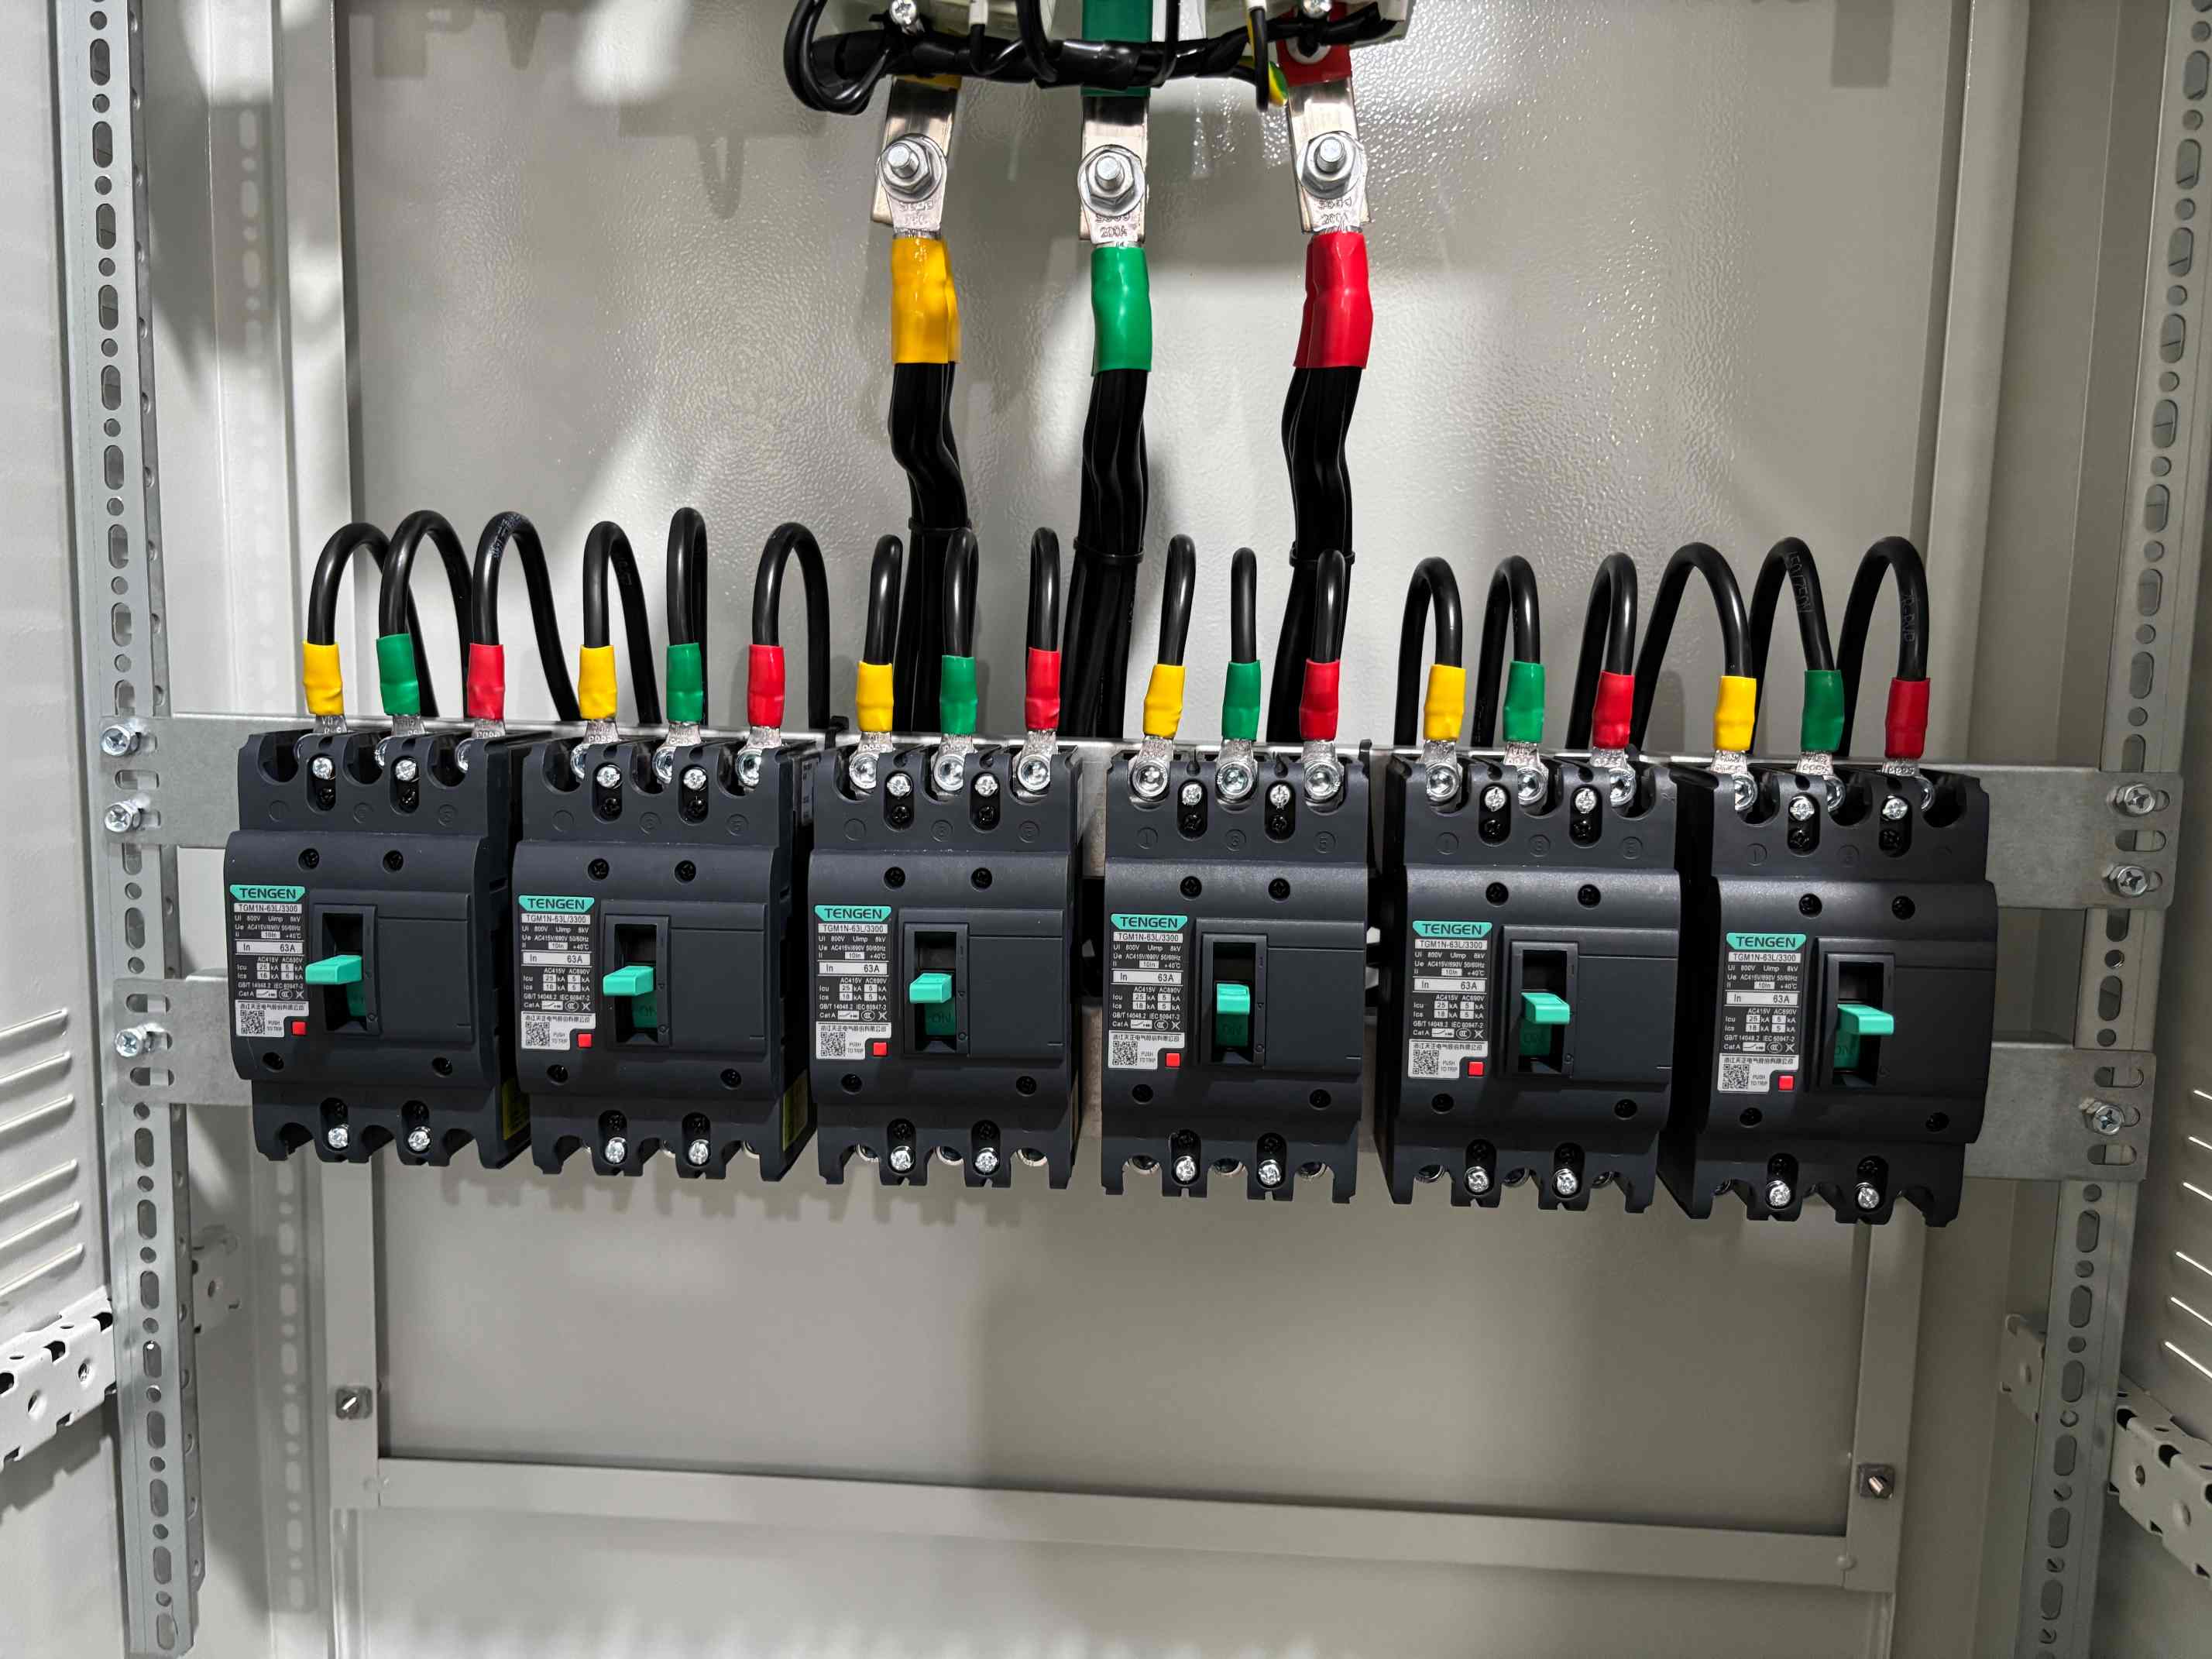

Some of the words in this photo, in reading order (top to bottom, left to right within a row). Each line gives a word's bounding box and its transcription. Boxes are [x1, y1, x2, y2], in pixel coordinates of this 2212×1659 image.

[239, 888, 296, 898] TENGEN
[527, 898, 585, 910] TENGEN
[825, 908, 882, 919] TENGEN
[1120, 916, 1177, 928] TENGEN
[823, 924, 884, 933] TGM1N-63L/3300
[1422, 923, 1482, 935] TENGEN
[1118, 933, 1179, 942] TGM1N-63L/3300
[1736, 936, 1796, 948] TENGEN
[1420, 939, 1483, 949] TGM1N-63L/3300
[530, 954, 538, 963] In
[1733, 953, 1797, 962] TGM1N-63L/3300
[1120, 973, 1128, 981] In
[1421, 981, 1429, 989] In
